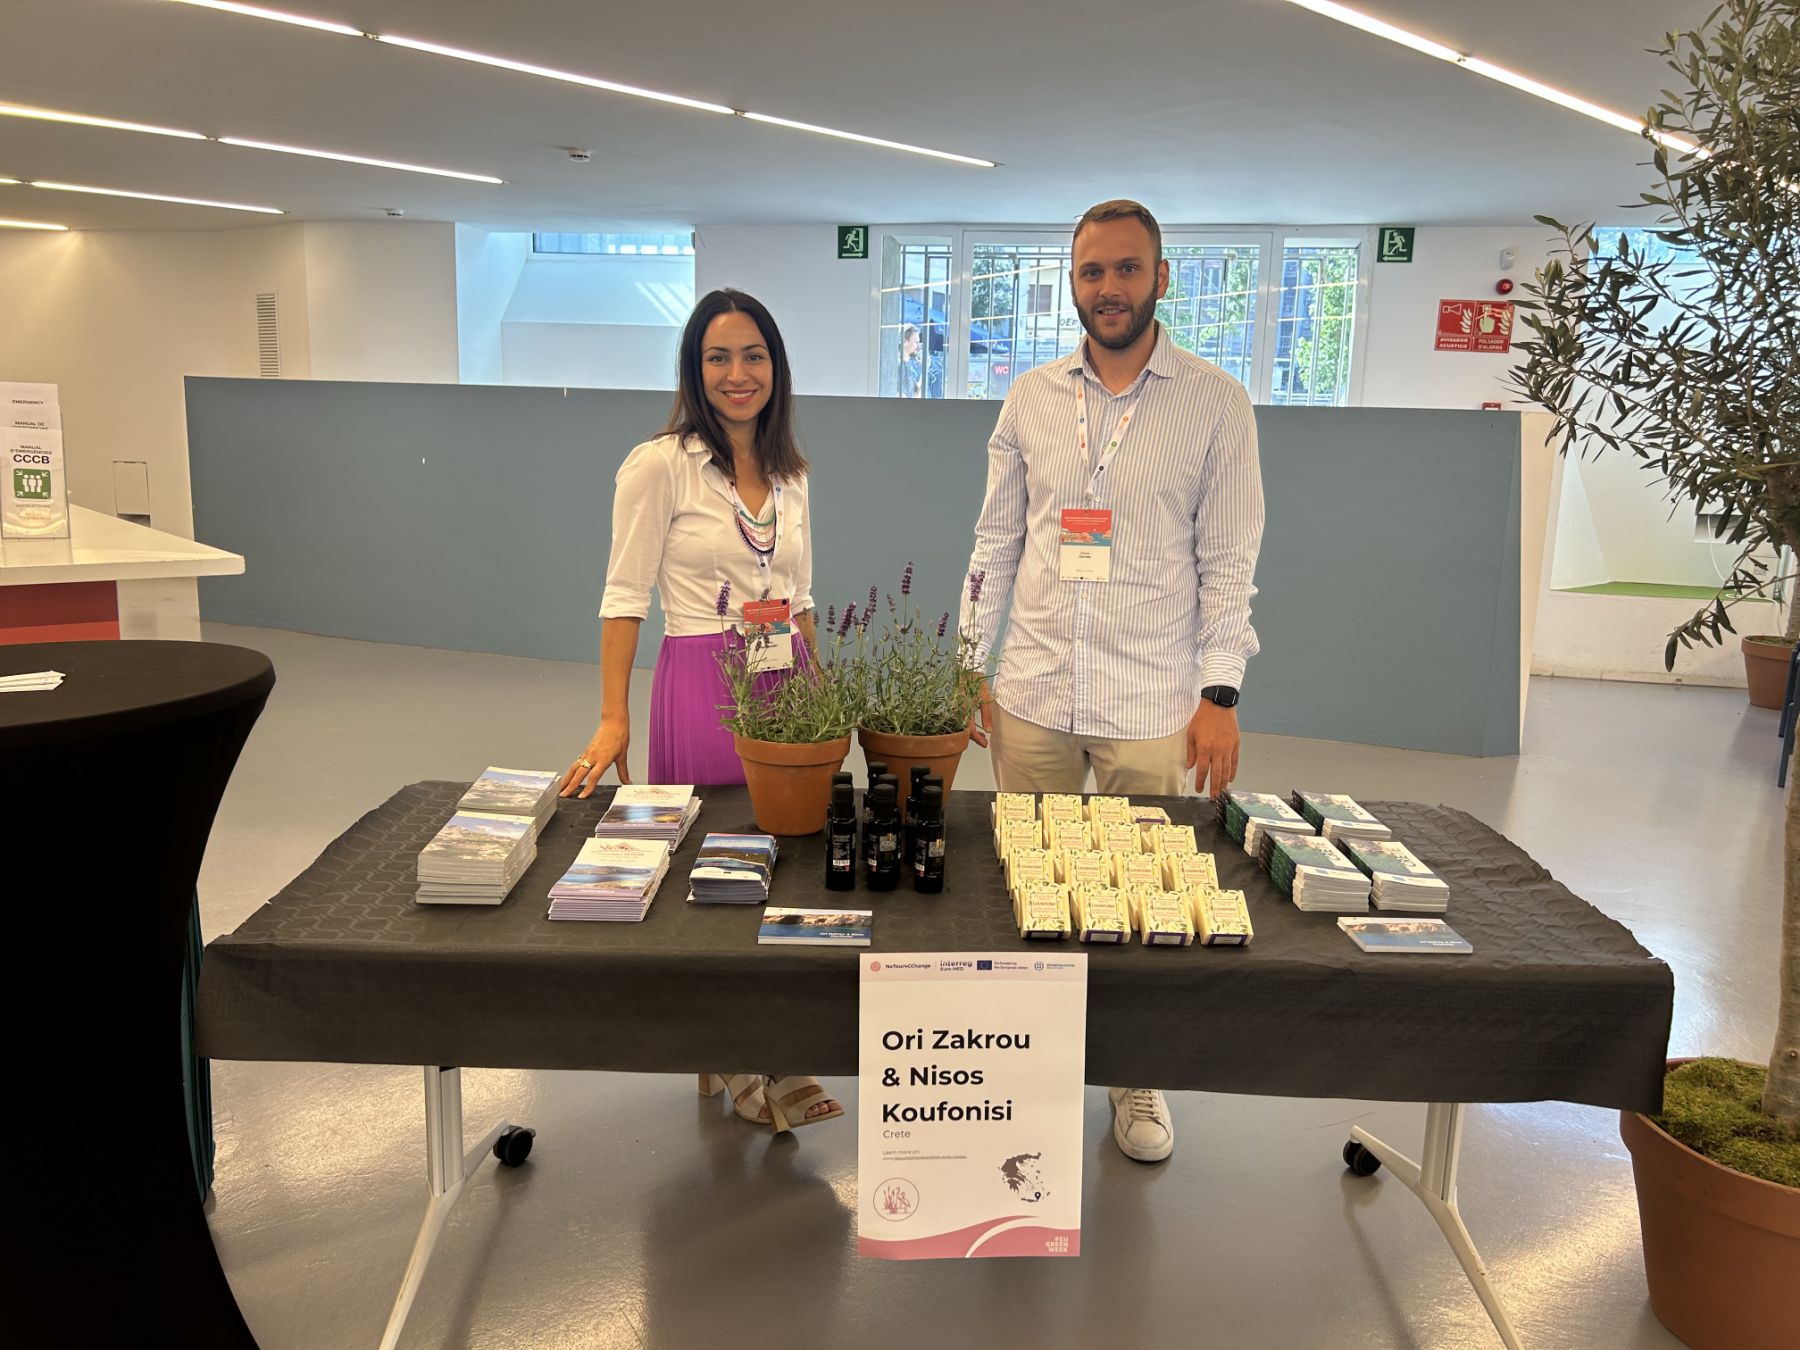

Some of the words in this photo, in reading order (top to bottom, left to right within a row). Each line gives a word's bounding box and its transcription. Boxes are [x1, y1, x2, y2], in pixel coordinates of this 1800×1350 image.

[995, 365, 1009, 375] WC
[13, 453, 50, 464] CCCB
[882, 1028, 923, 1051] Ori
[932, 1029, 1030, 1050] Zakrou
[882, 1067, 900, 1087] &
[910, 1064, 984, 1086] Nisos
[882, 1099, 1012, 1123] Koufonisi
[883, 1129, 911, 1139] Crete
